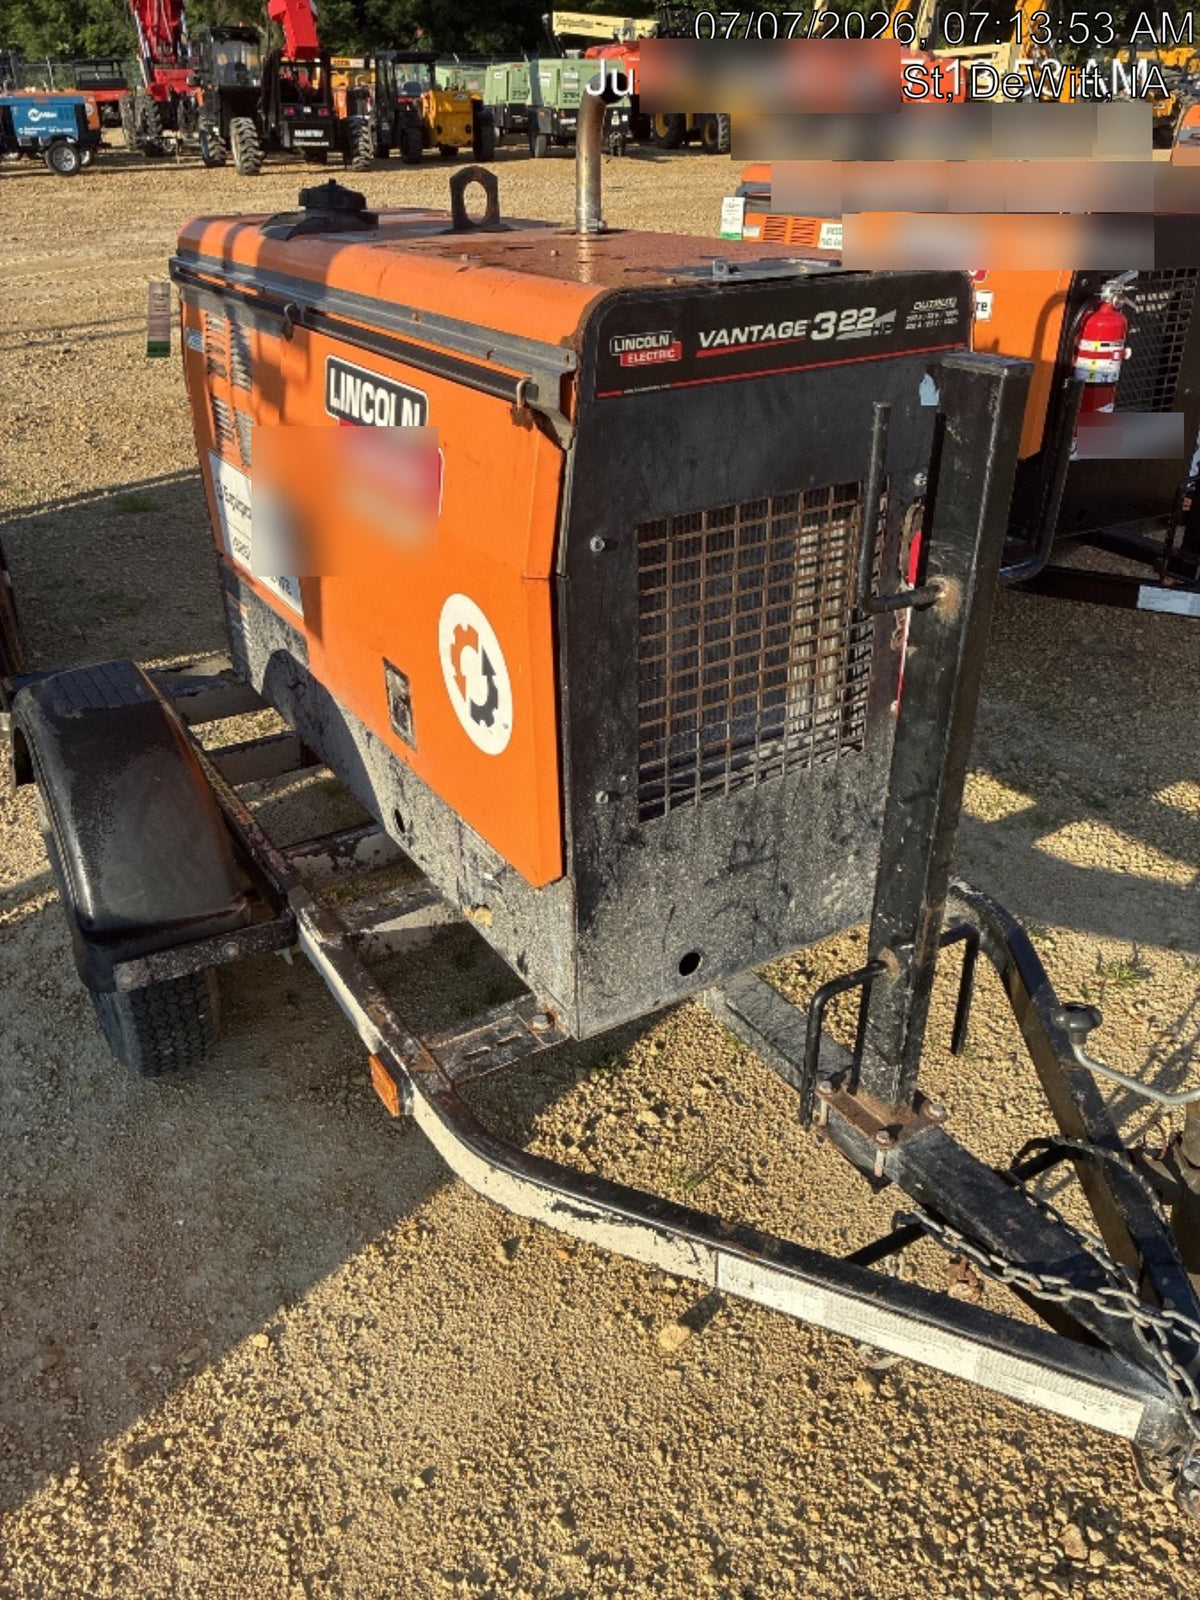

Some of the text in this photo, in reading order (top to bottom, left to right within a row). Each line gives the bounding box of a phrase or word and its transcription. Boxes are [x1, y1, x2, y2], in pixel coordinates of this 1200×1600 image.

[698, 319, 809, 348] VANTAGE
[810, 307, 877, 341] 322
[614, 333, 670, 353] LINCOLN
[627, 348, 676, 364] ELECTRIC
[329, 367, 421, 427] LINCOLN
